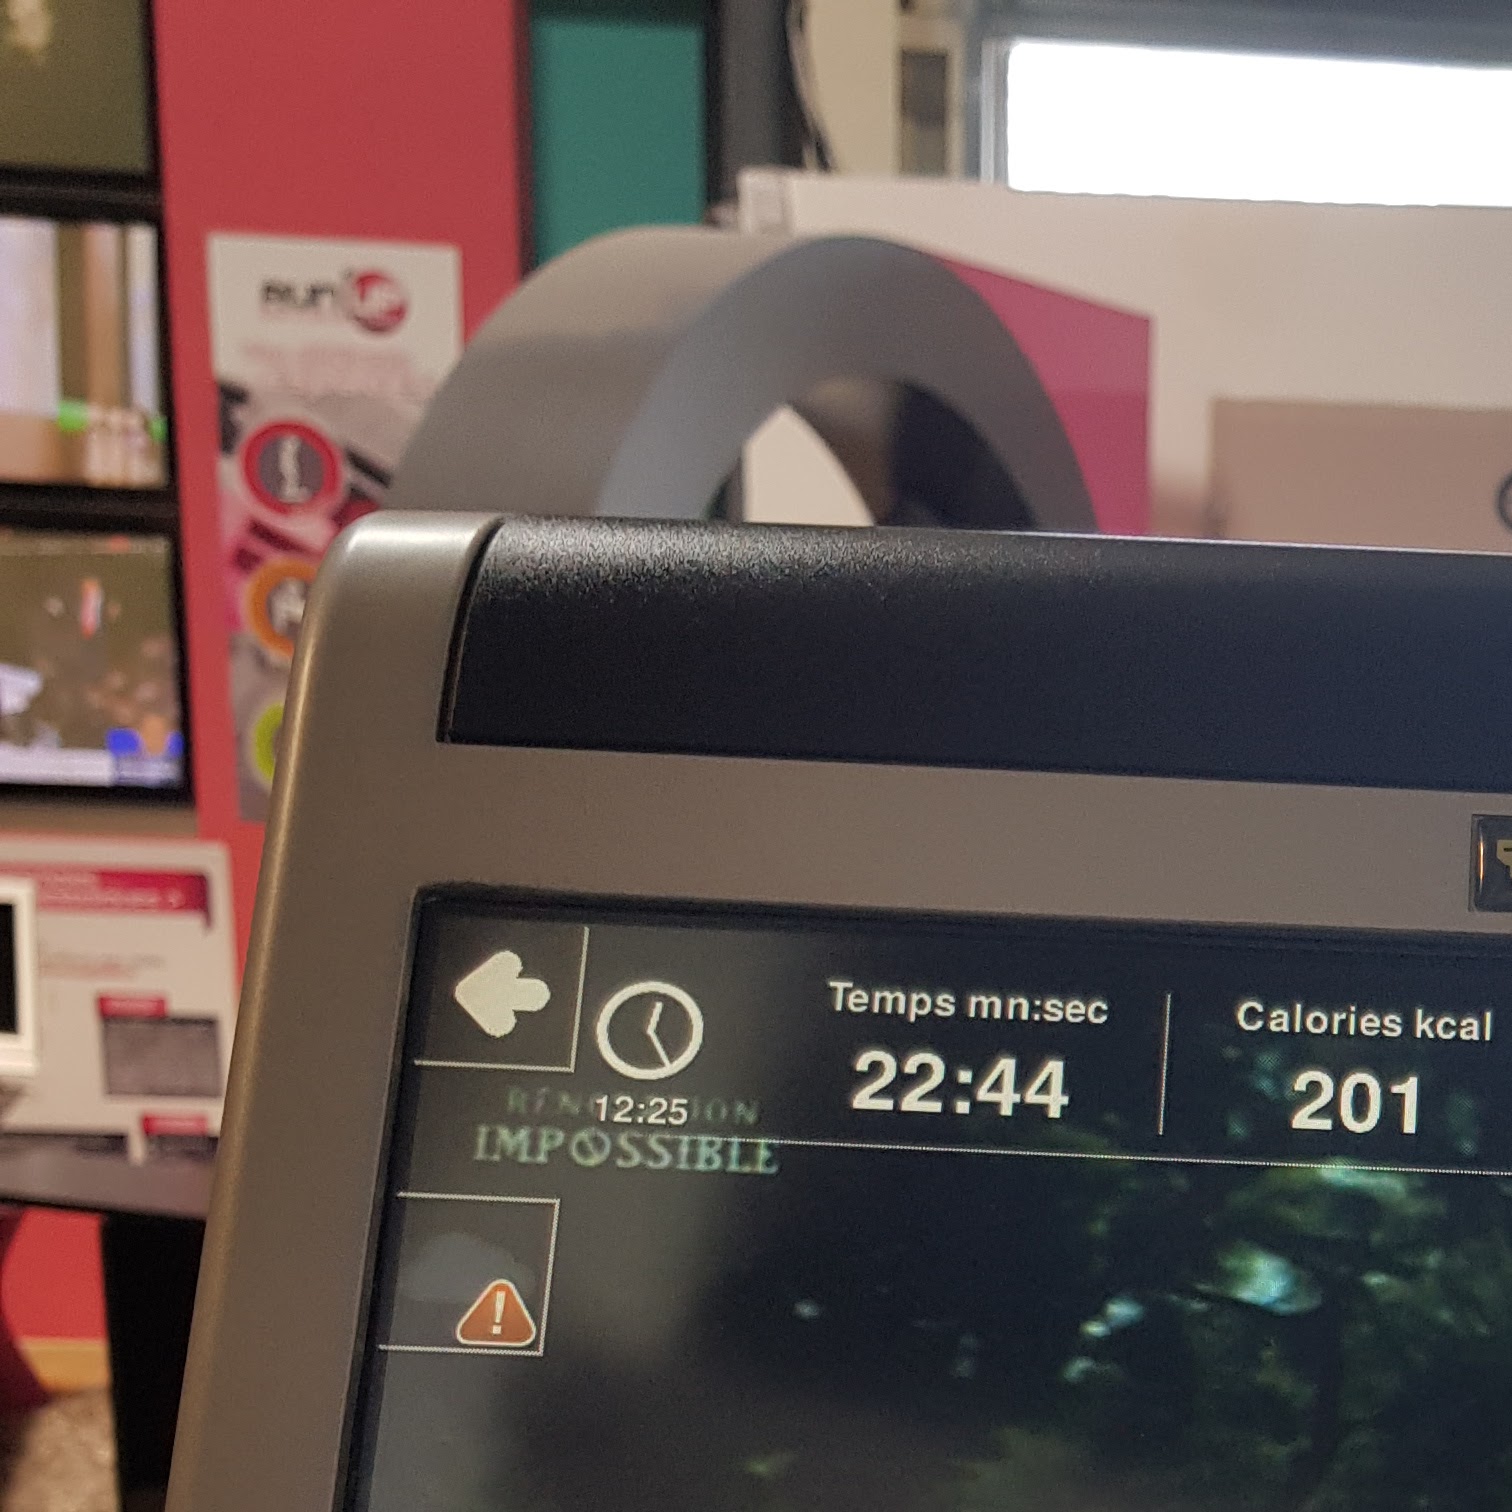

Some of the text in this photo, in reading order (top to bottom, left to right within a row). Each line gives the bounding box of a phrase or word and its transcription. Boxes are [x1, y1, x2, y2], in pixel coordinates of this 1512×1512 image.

[829, 980, 1110, 1024] Temps mn:sec
[1236, 1000, 1493, 1042] Calories kcal
[851, 1050, 1070, 1119] 22:44
[1291, 1070, 1419, 1134] 201
[594, 1094, 689, 1125] 12:25
[473, 1124, 781, 1175] IMPOSSIBLE
